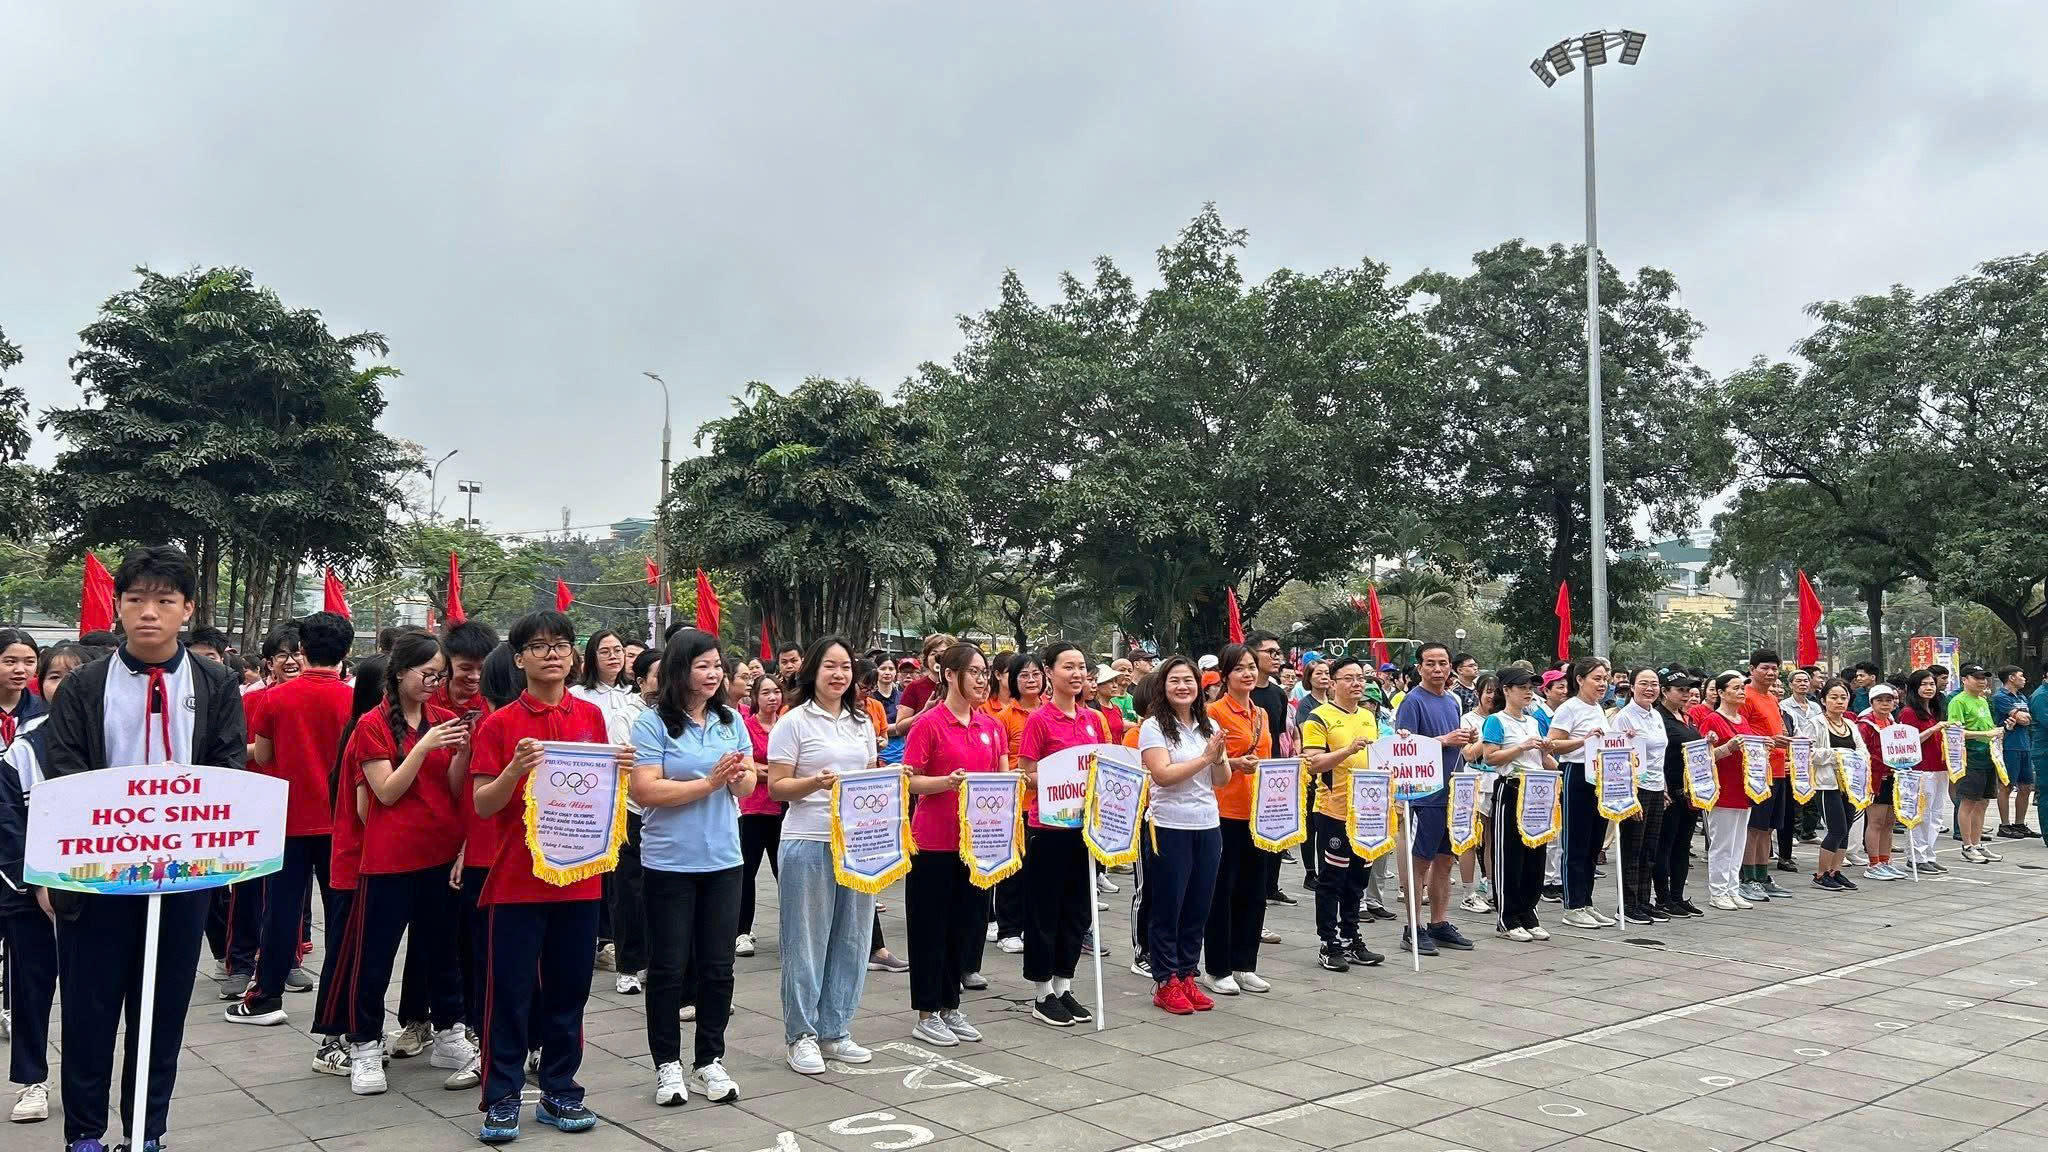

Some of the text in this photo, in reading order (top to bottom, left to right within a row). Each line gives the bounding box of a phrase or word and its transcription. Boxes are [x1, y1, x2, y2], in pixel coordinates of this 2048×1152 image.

[1392, 738, 1417, 757] KHỐI
[1392, 762, 1413, 779] DÂN
[1415, 760, 1435, 778] PHỐ
[127, 773, 202, 796] KHỐI
[1046, 779, 1087, 802] TRƯỜNG
[91, 804, 231, 828] HỌC SINH
[57, 830, 260, 855] TRƯỜNG THPT
